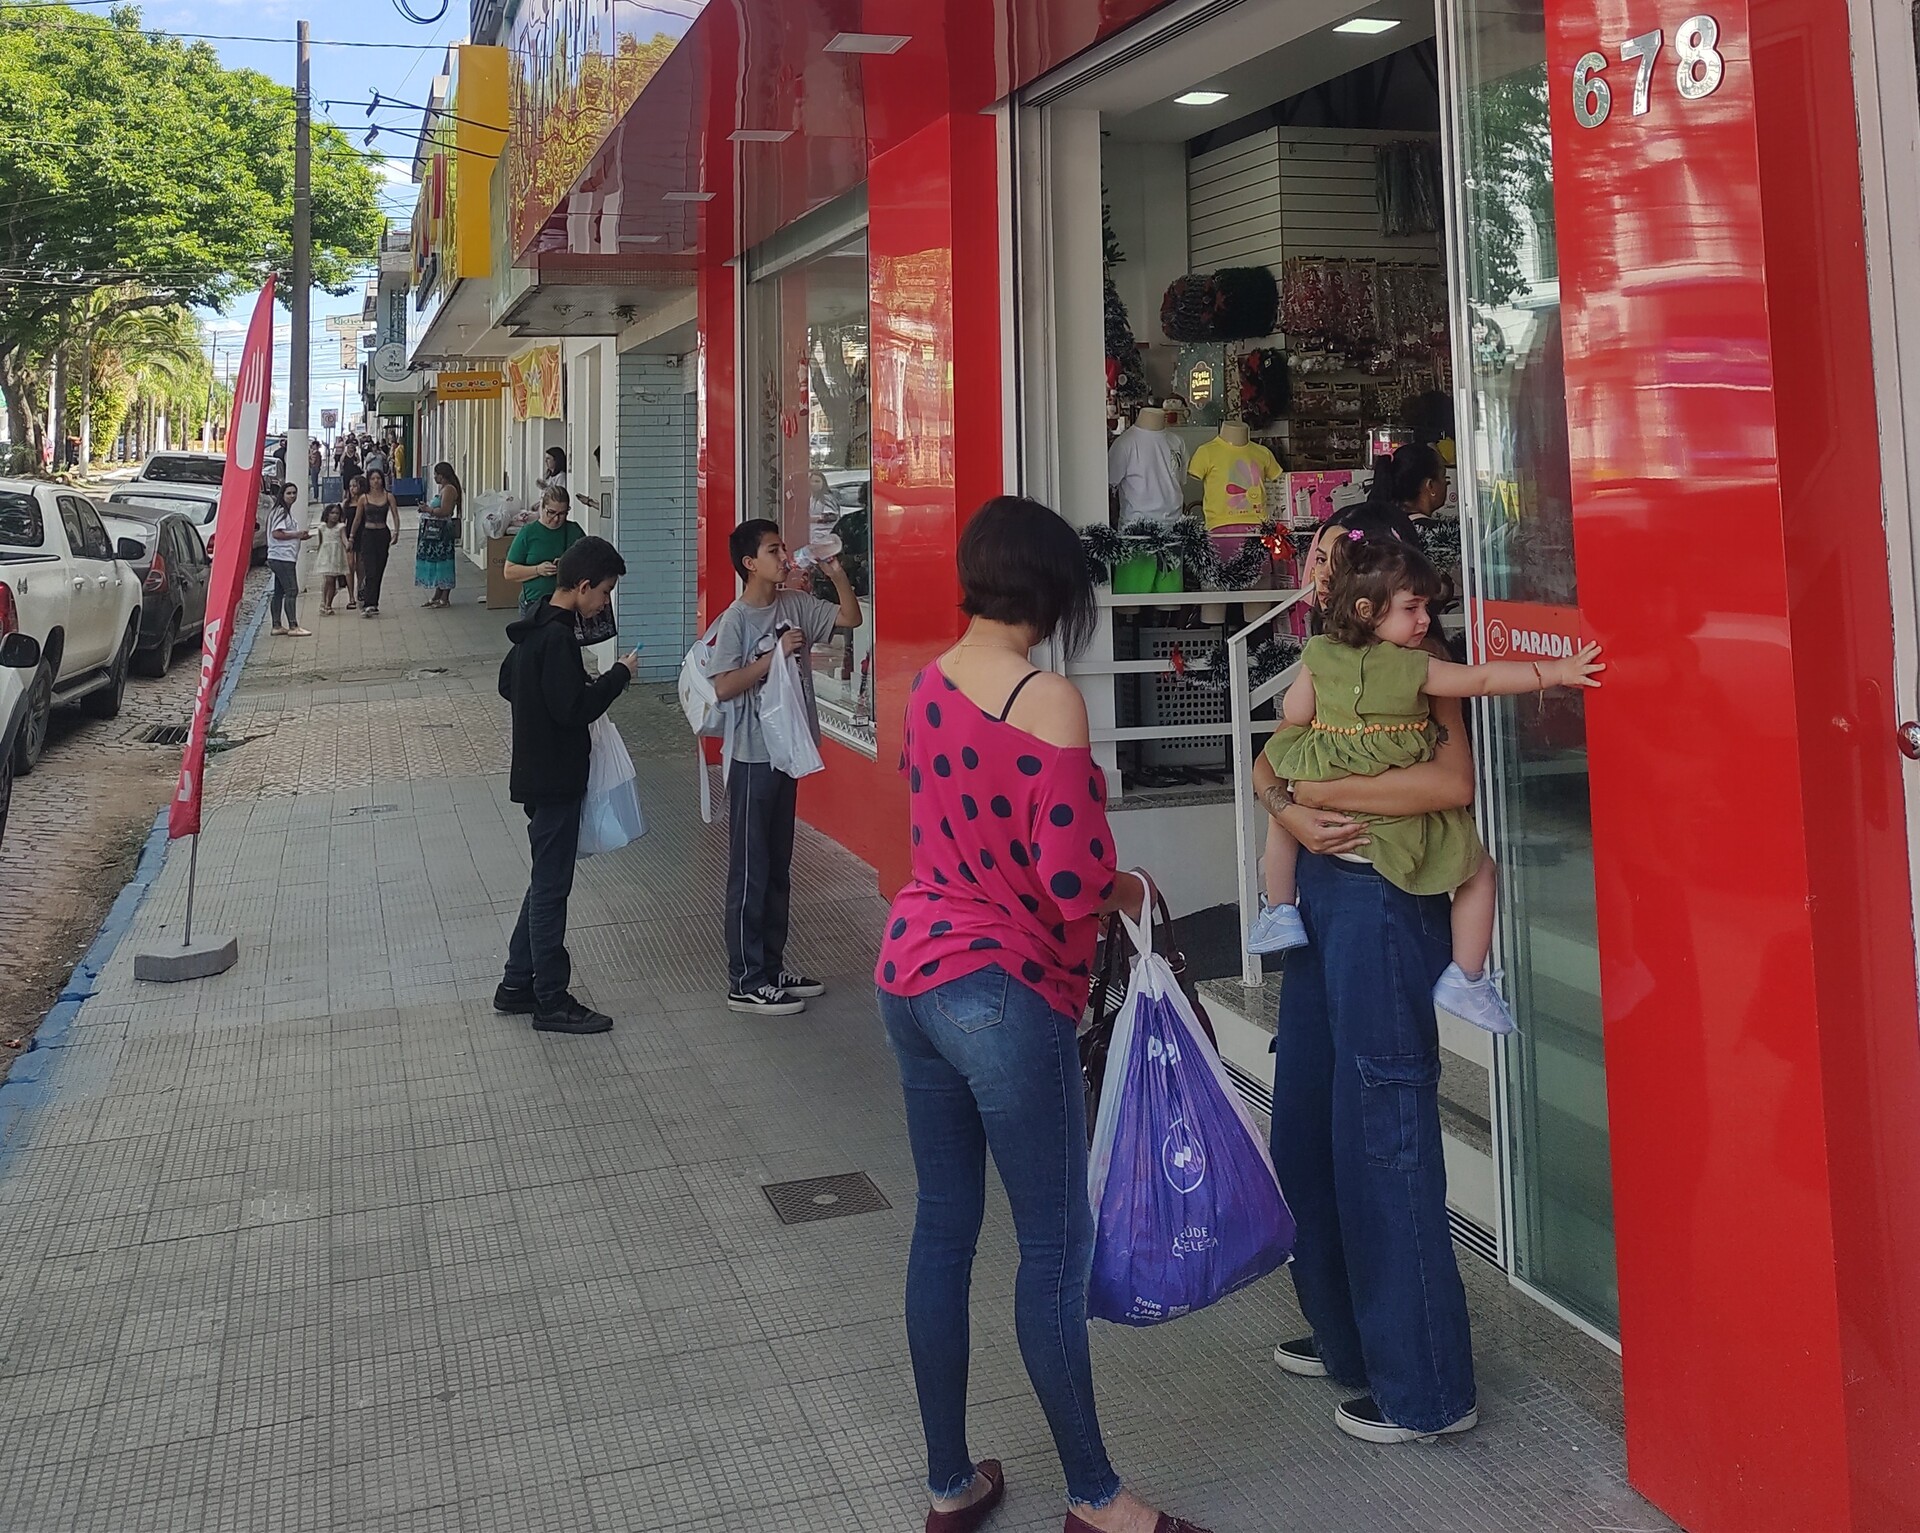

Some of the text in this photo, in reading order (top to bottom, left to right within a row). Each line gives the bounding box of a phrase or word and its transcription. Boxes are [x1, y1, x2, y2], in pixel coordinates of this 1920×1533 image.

[1573, 15, 1725, 129] 678
[1192, 379, 1210, 388] Natal
[1511, 628, 1573, 658] PARADA
[1135, 1296, 1161, 1310] Baixe
